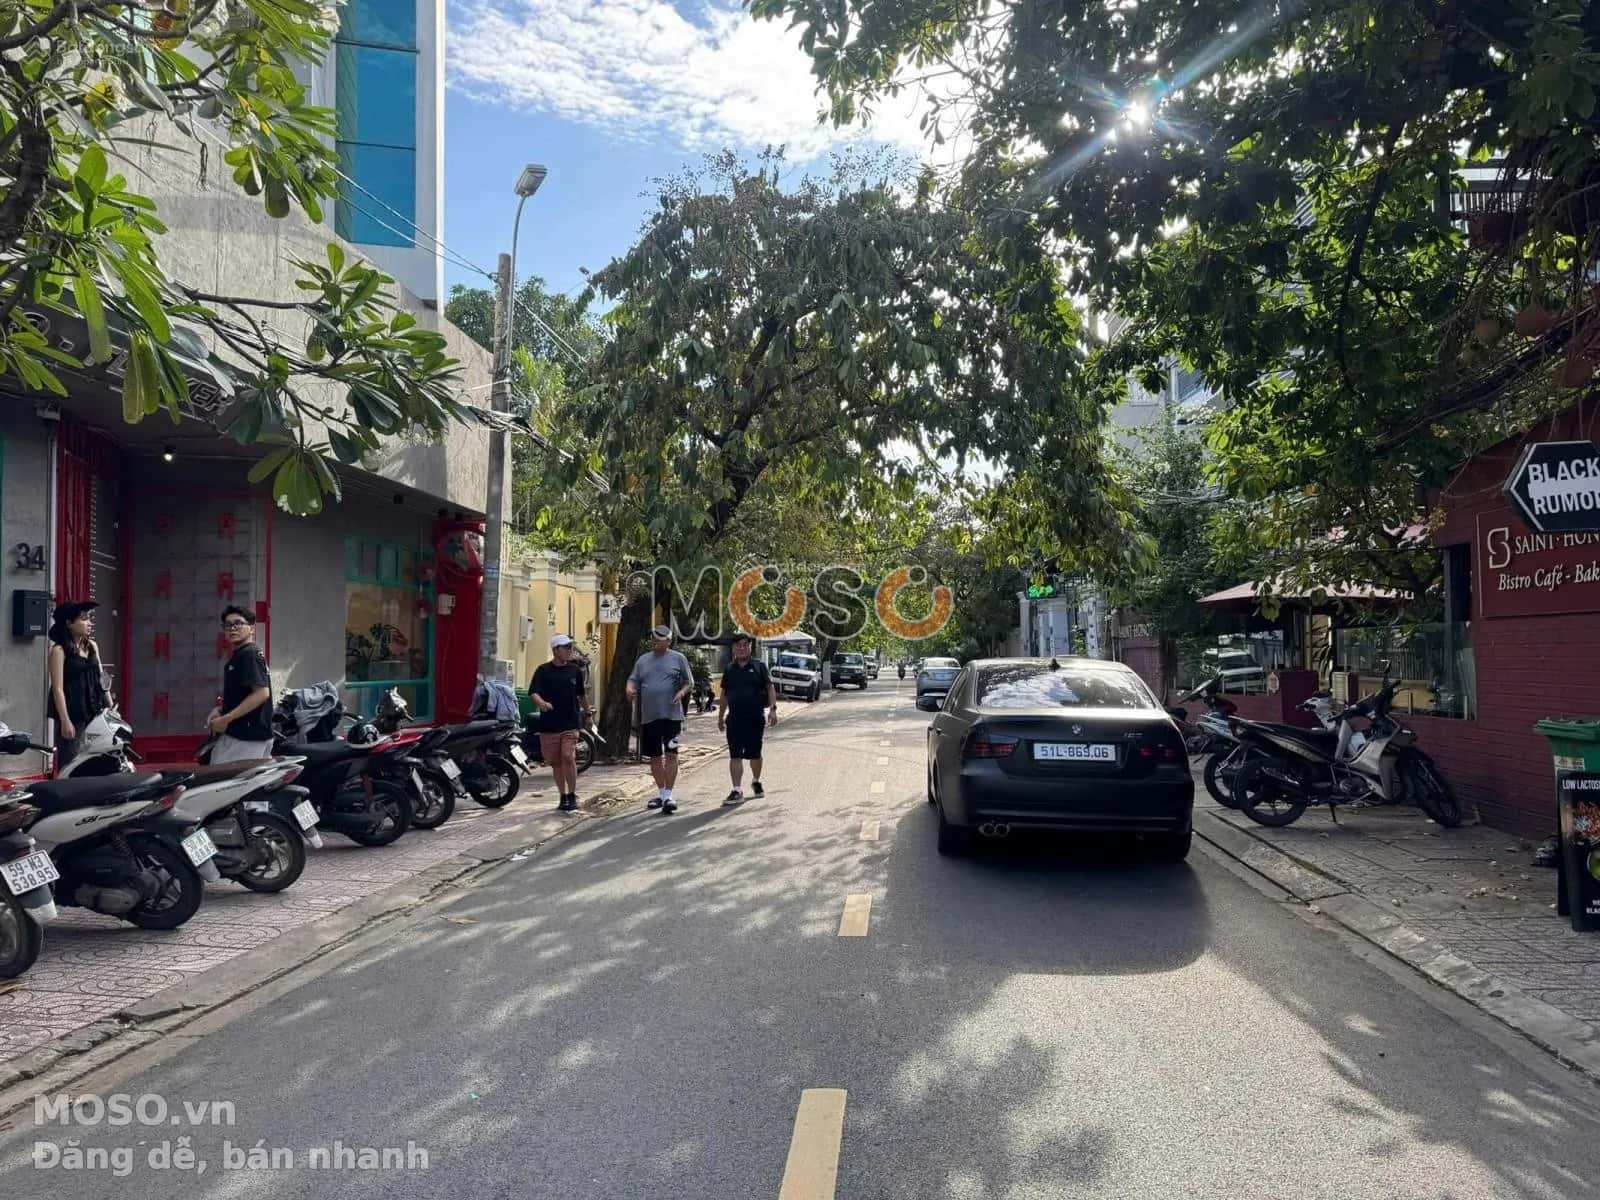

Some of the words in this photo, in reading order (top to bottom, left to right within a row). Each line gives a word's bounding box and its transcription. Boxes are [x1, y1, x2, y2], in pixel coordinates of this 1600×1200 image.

[1528, 457, 1600, 483] BLACK
[16, 542, 46, 570] 34
[1498, 573, 1531, 591] Bistro
[1535, 563, 1563, 591] Café
[12, 867, 54, 892] 538.95
